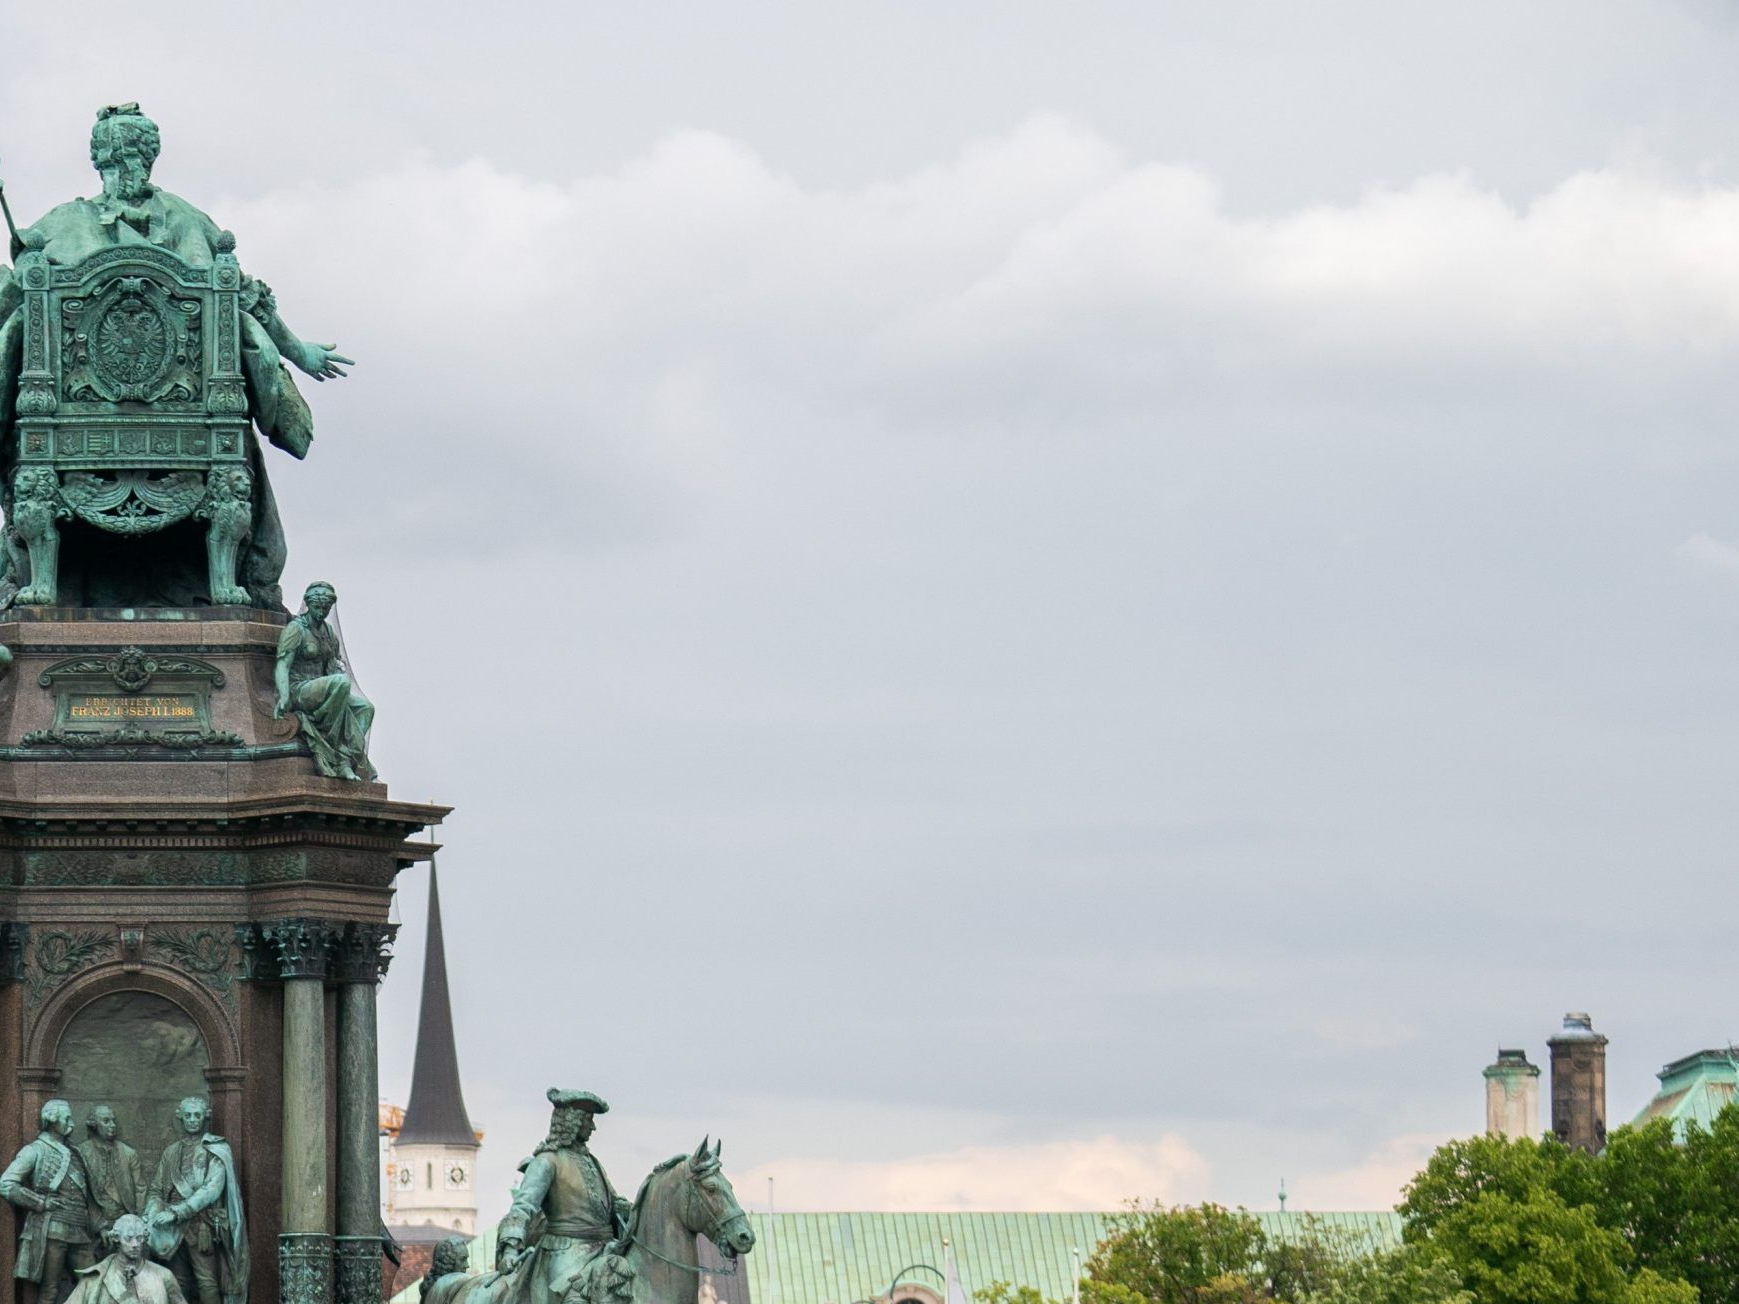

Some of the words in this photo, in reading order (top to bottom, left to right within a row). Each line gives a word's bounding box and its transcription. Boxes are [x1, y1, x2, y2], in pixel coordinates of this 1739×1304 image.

[85, 697, 151, 706] ERRICHTET
[157, 697, 179, 706] VON
[71, 705, 111, 717] FRANZ
[113, 705, 161, 717] JOSEPH
